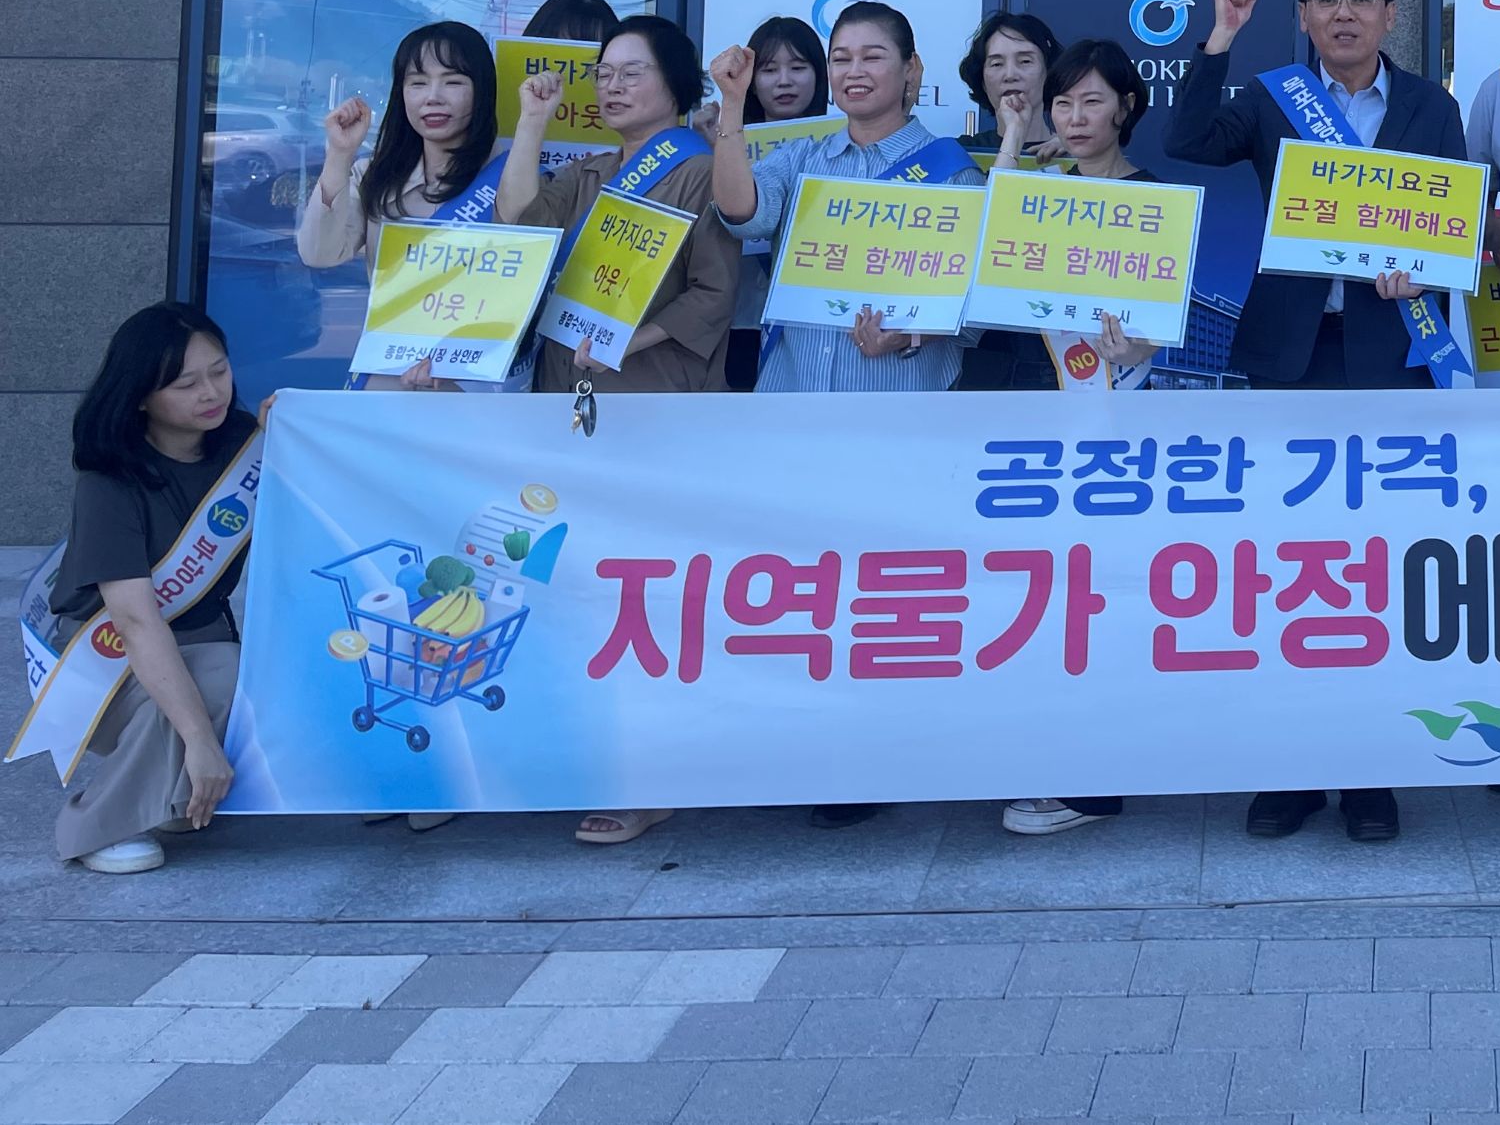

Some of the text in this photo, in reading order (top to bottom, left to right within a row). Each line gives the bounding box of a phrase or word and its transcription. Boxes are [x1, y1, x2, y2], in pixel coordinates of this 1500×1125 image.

[554, 101, 603, 130] 아웃
[1310, 159, 1453, 199] 바가지요금
[826, 197, 962, 234] 바가지요금
[1021, 194, 1165, 234] 바가지요금
[1282, 196, 1469, 240] 근절 함께해요
[599, 212, 668, 260] 바가지요금
[405, 242, 524, 278] 바가지요금
[793, 239, 967, 279] 근절 함께해요
[989, 238, 1178, 282] 근절 함께해요
[593, 263, 621, 297] 아웃
[422, 291, 466, 321] 아웃
[558, 309, 615, 348] 종합수산시장 상인회
[384, 344, 484, 365] 종합수산시장 상인회
[1068, 350, 1096, 374] NO
[974, 433, 1256, 520] 공정한
[1281, 430, 1488, 513] 가격,
[211, 504, 246, 532] YES
[155, 534, 219, 609] 부당요
[586, 541, 1107, 684] 지역물가
